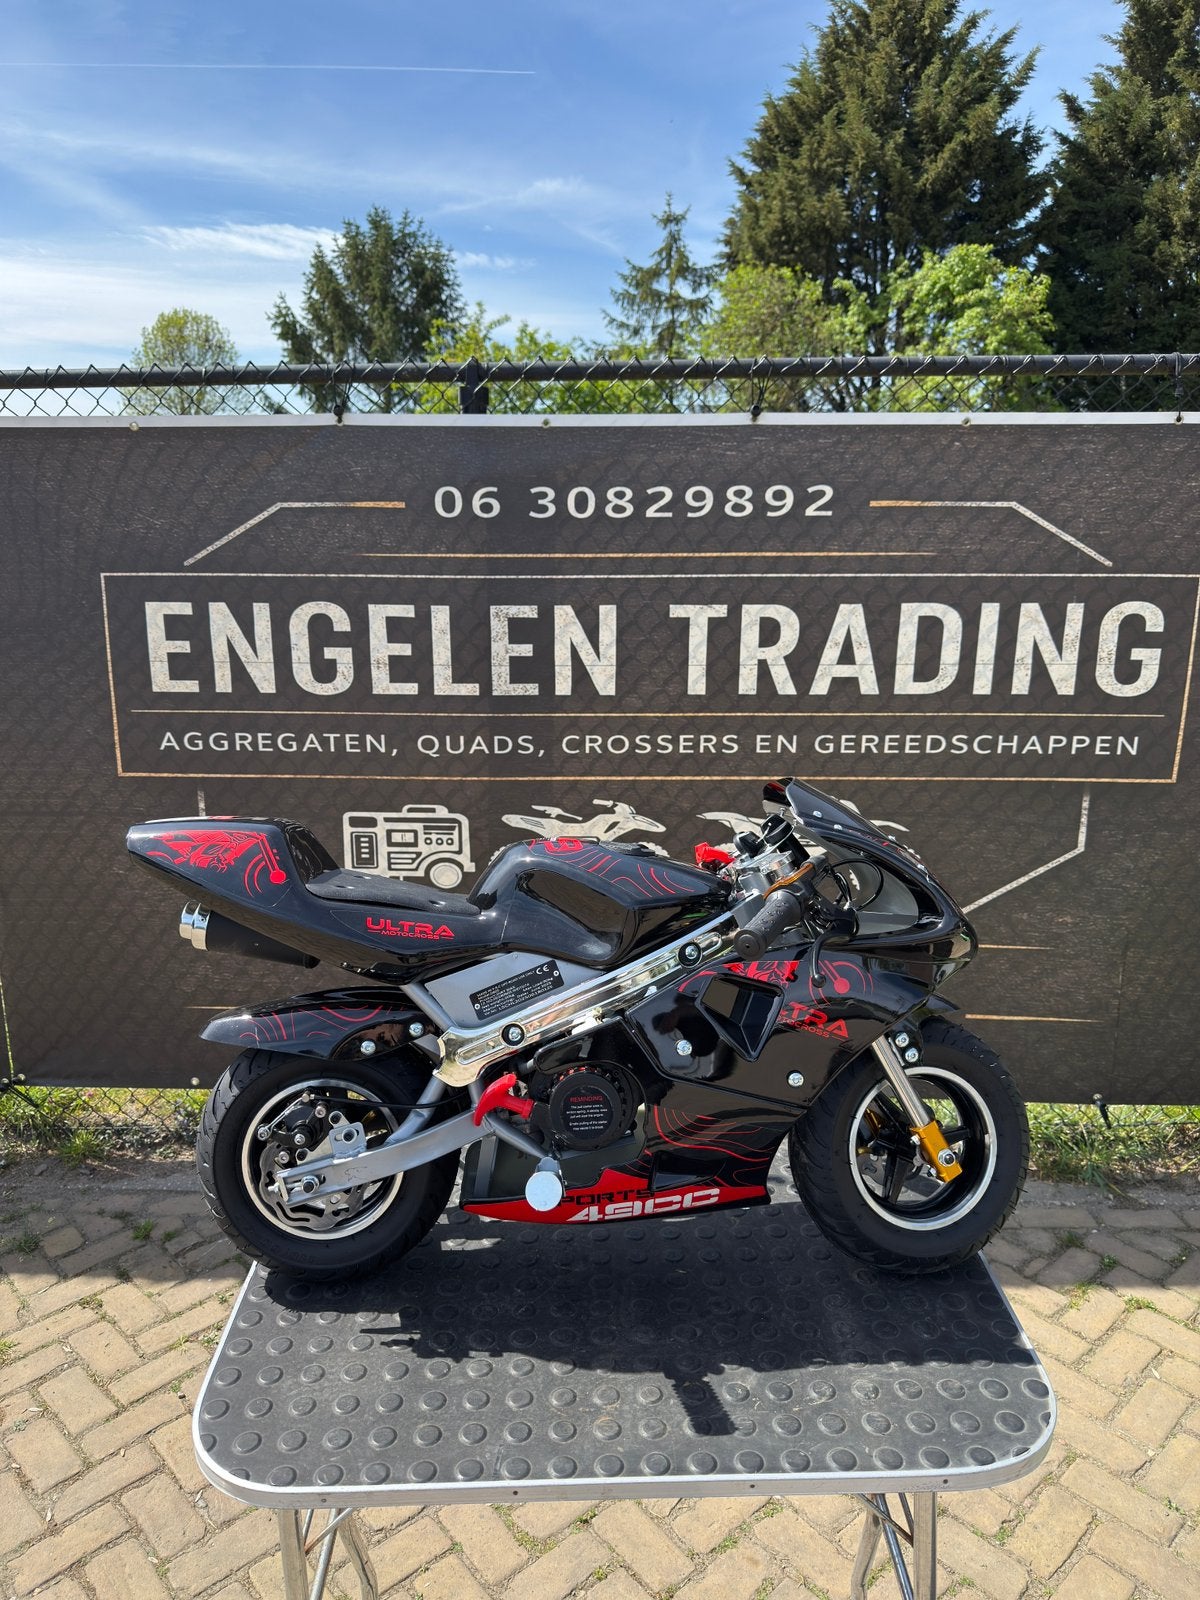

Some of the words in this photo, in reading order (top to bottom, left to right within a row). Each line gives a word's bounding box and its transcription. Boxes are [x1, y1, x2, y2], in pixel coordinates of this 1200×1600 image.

[434, 485, 501, 519] 06
[528, 484, 834, 519] 30829892
[144, 601, 617, 697] ENGELEN
[668, 600, 1165, 698] TRADING
[159, 731, 400, 759] AGGREGATEN,
[416, 734, 547, 760] QUADS,
[561, 734, 739, 755] CROSSERS
[755, 734, 798, 754] EN
[814, 734, 1139, 756] GEREEDSCHAPPEN
[366, 917, 454, 937] ULTRA
[381, 930, 439, 940] MOTOCROSS
[780, 1001, 849, 1038] TRA
[560, 1190, 655, 1206] PORTS
[566, 1187, 723, 1222] 49CC
